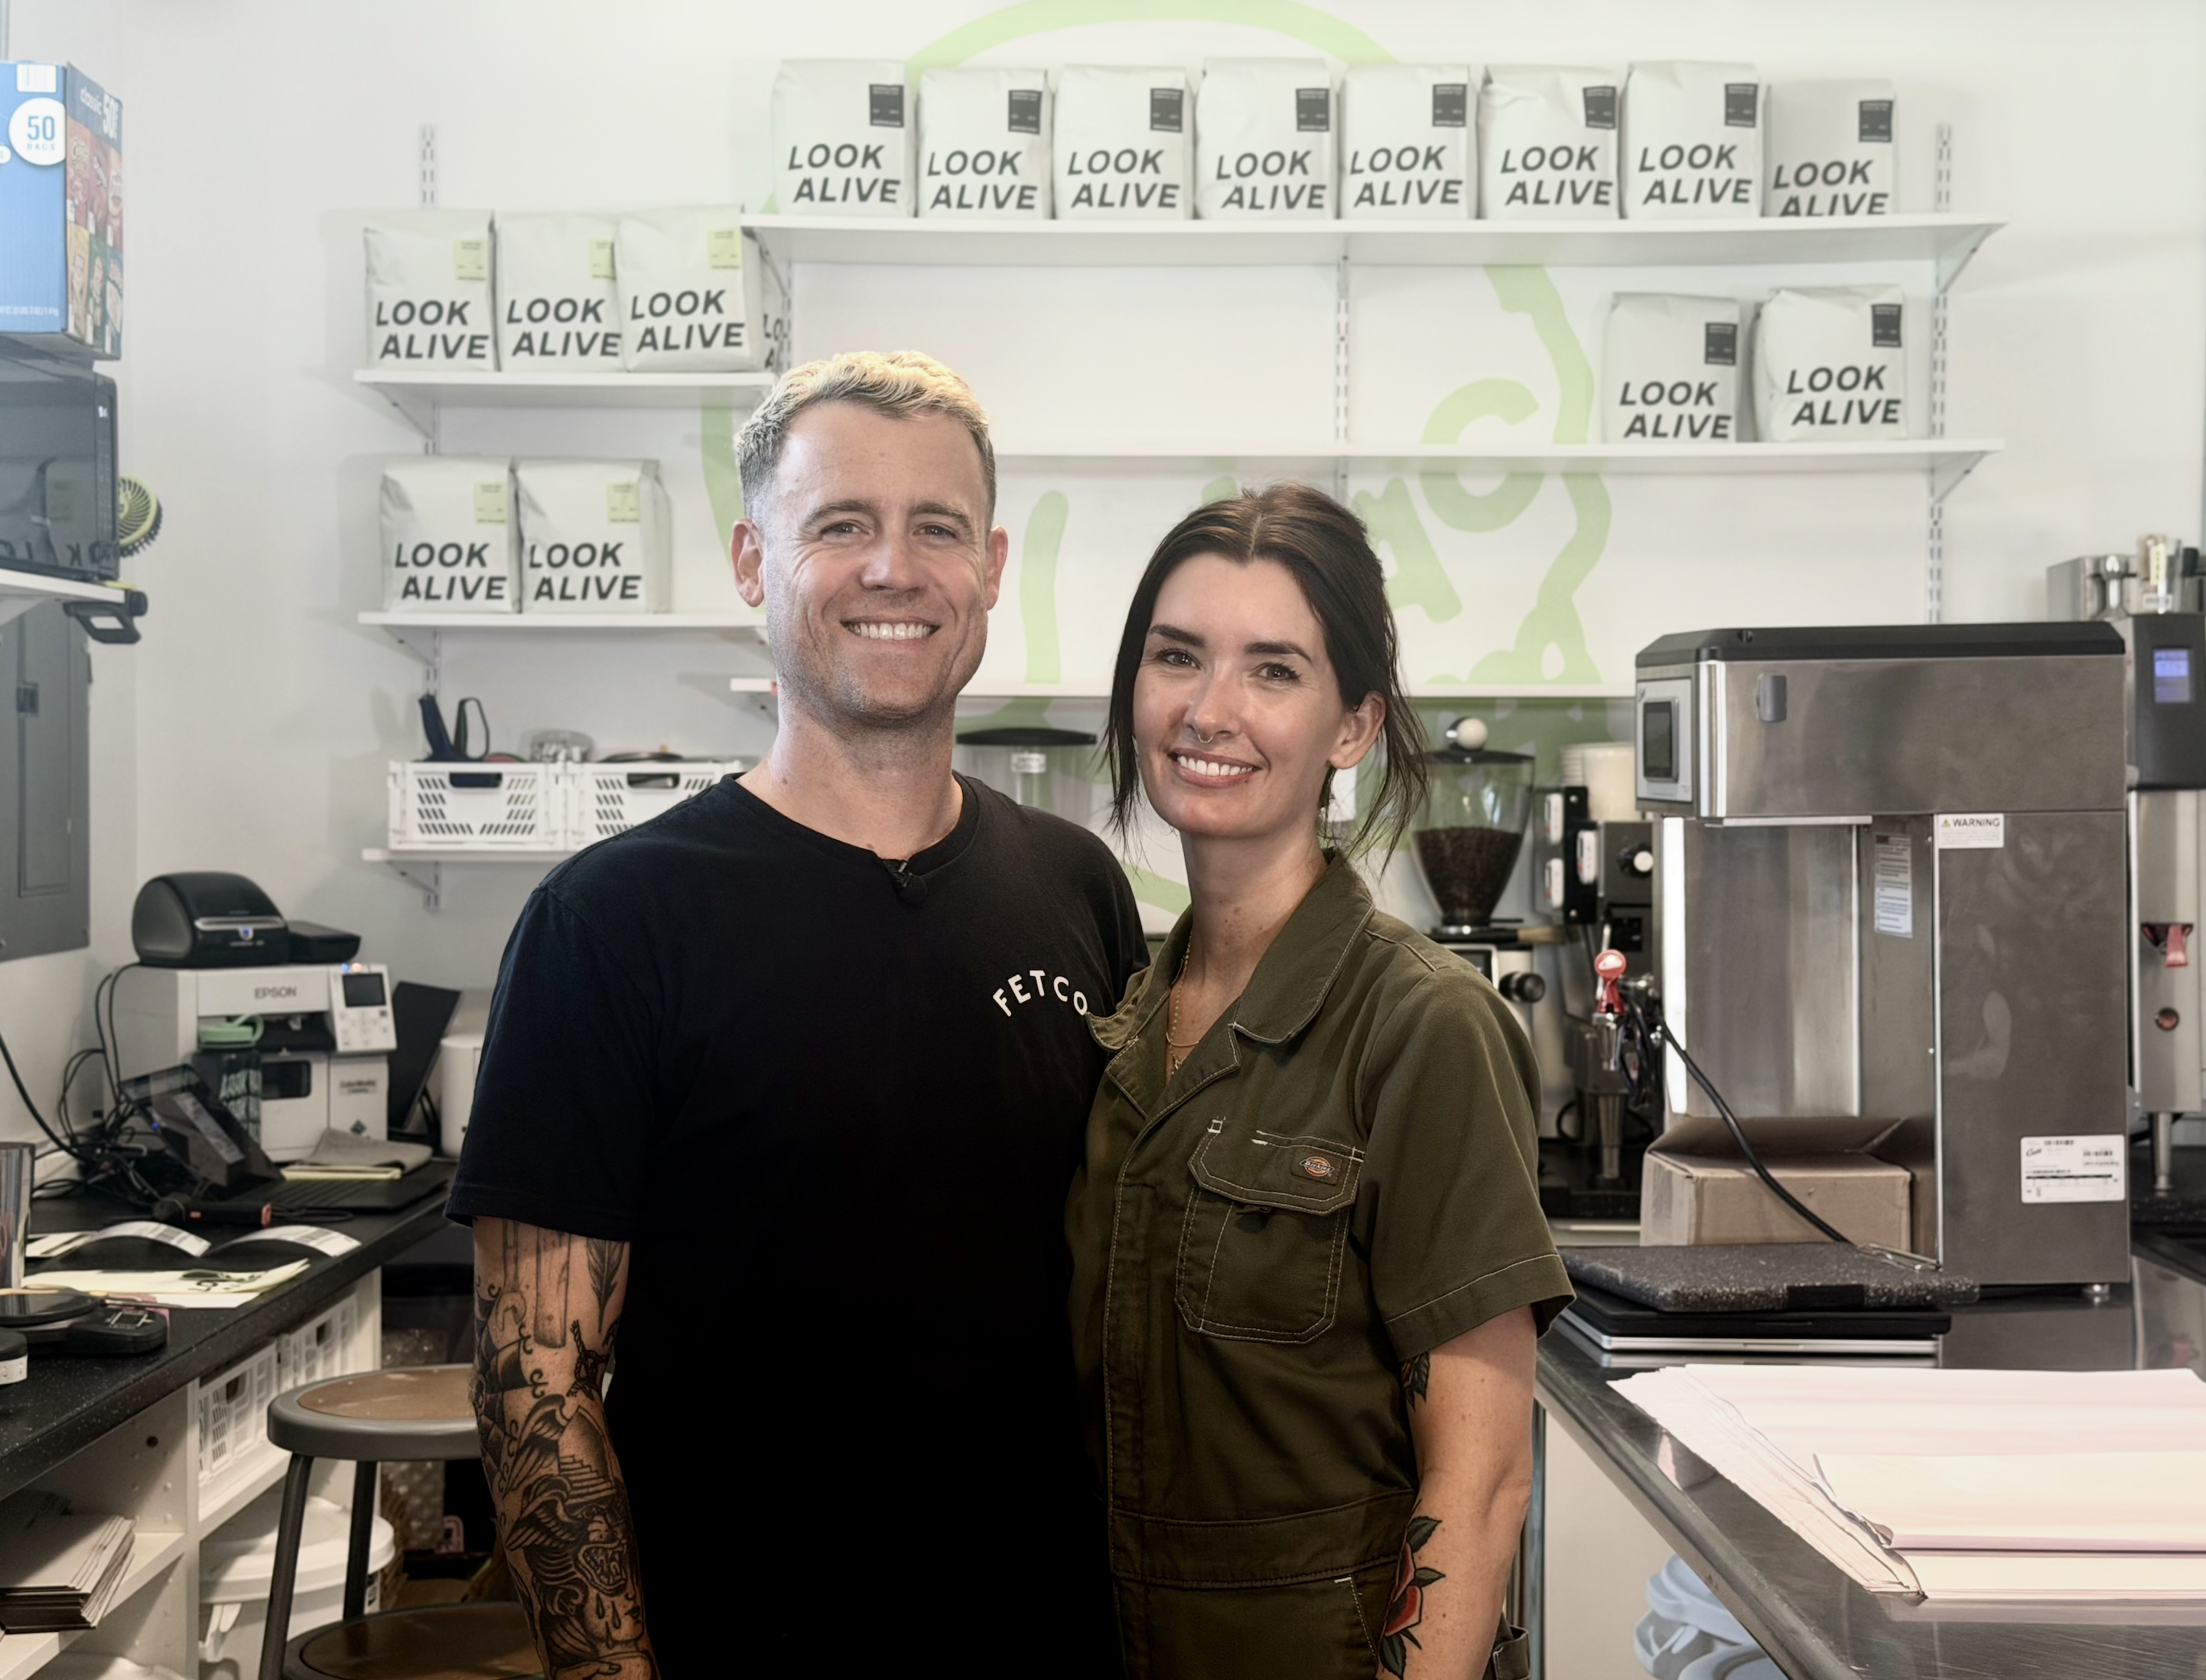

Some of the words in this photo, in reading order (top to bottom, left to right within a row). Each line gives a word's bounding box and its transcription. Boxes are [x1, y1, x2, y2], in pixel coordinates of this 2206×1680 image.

[28, 116, 55, 141] 50
[27, 143, 56, 151] BAGS
[788, 144, 886, 171] LOOK
[1349, 145, 1447, 174] LOOK
[1500, 145, 1599, 174] LOOK
[1638, 145, 1737, 173] LOOK
[926, 151, 1023, 177] LOOK
[1068, 149, 1164, 175] LOOK
[1215, 150, 1312, 180] LOOK
[1773, 161, 1873, 189] LOOK
[792, 177, 902, 203] ALIVE
[930, 184, 1038, 210] ALIVE
[1071, 183, 1179, 208] ALIVE
[1221, 185, 1326, 210] ALIVE
[1353, 179, 1463, 208] ALIVE
[1505, 179, 1614, 206] ALIVE
[1643, 179, 1752, 205] ALIVE
[1778, 193, 1889, 217] ALIVE
[376, 301, 470, 326] LOOK
[506, 298, 605, 324] LOOK
[630, 290, 725, 320] LOOK
[379, 334, 490, 359] ALIVE
[512, 331, 621, 357] ALIVE
[636, 323, 745, 352] ALIVE
[1619, 382, 1718, 405] LOOK
[1787, 366, 1887, 395] LOOK
[1791, 399, 1901, 425] ALIVE
[1623, 414, 1732, 438] ALIVE
[395, 543, 490, 568] LOOK
[529, 542, 623, 568] LOOK
[402, 576, 507, 600] ALIVE
[535, 575, 641, 601] ALIVE
[1952, 818, 2001, 828] WARNING
[255, 986, 297, 999] EPSON
[992, 969, 1088, 1017] FETCO
